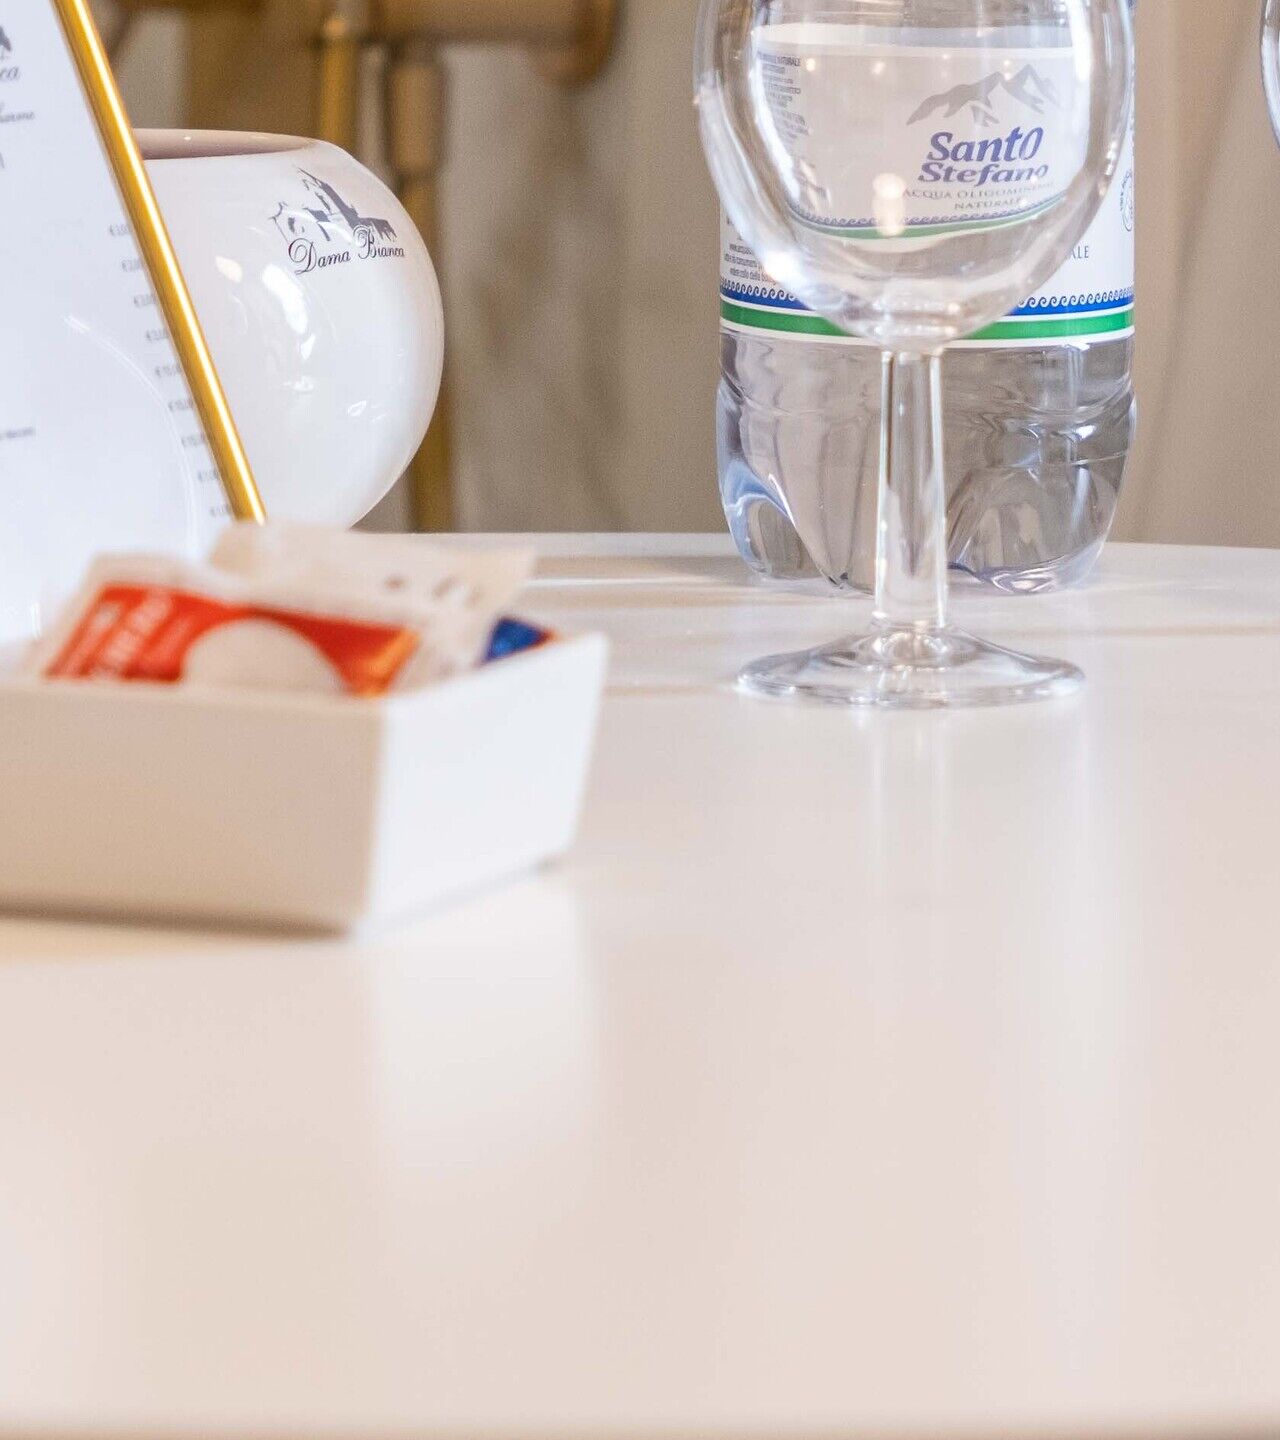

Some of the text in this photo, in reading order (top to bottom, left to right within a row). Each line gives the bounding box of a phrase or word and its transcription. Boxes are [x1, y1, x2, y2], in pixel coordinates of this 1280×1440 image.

[926, 126, 1044, 162] Santo
[918, 162, 1049, 187] Stefano
[903, 188, 952, 200] ACQUA
[288, 225, 405, 275] Dama Bianca
